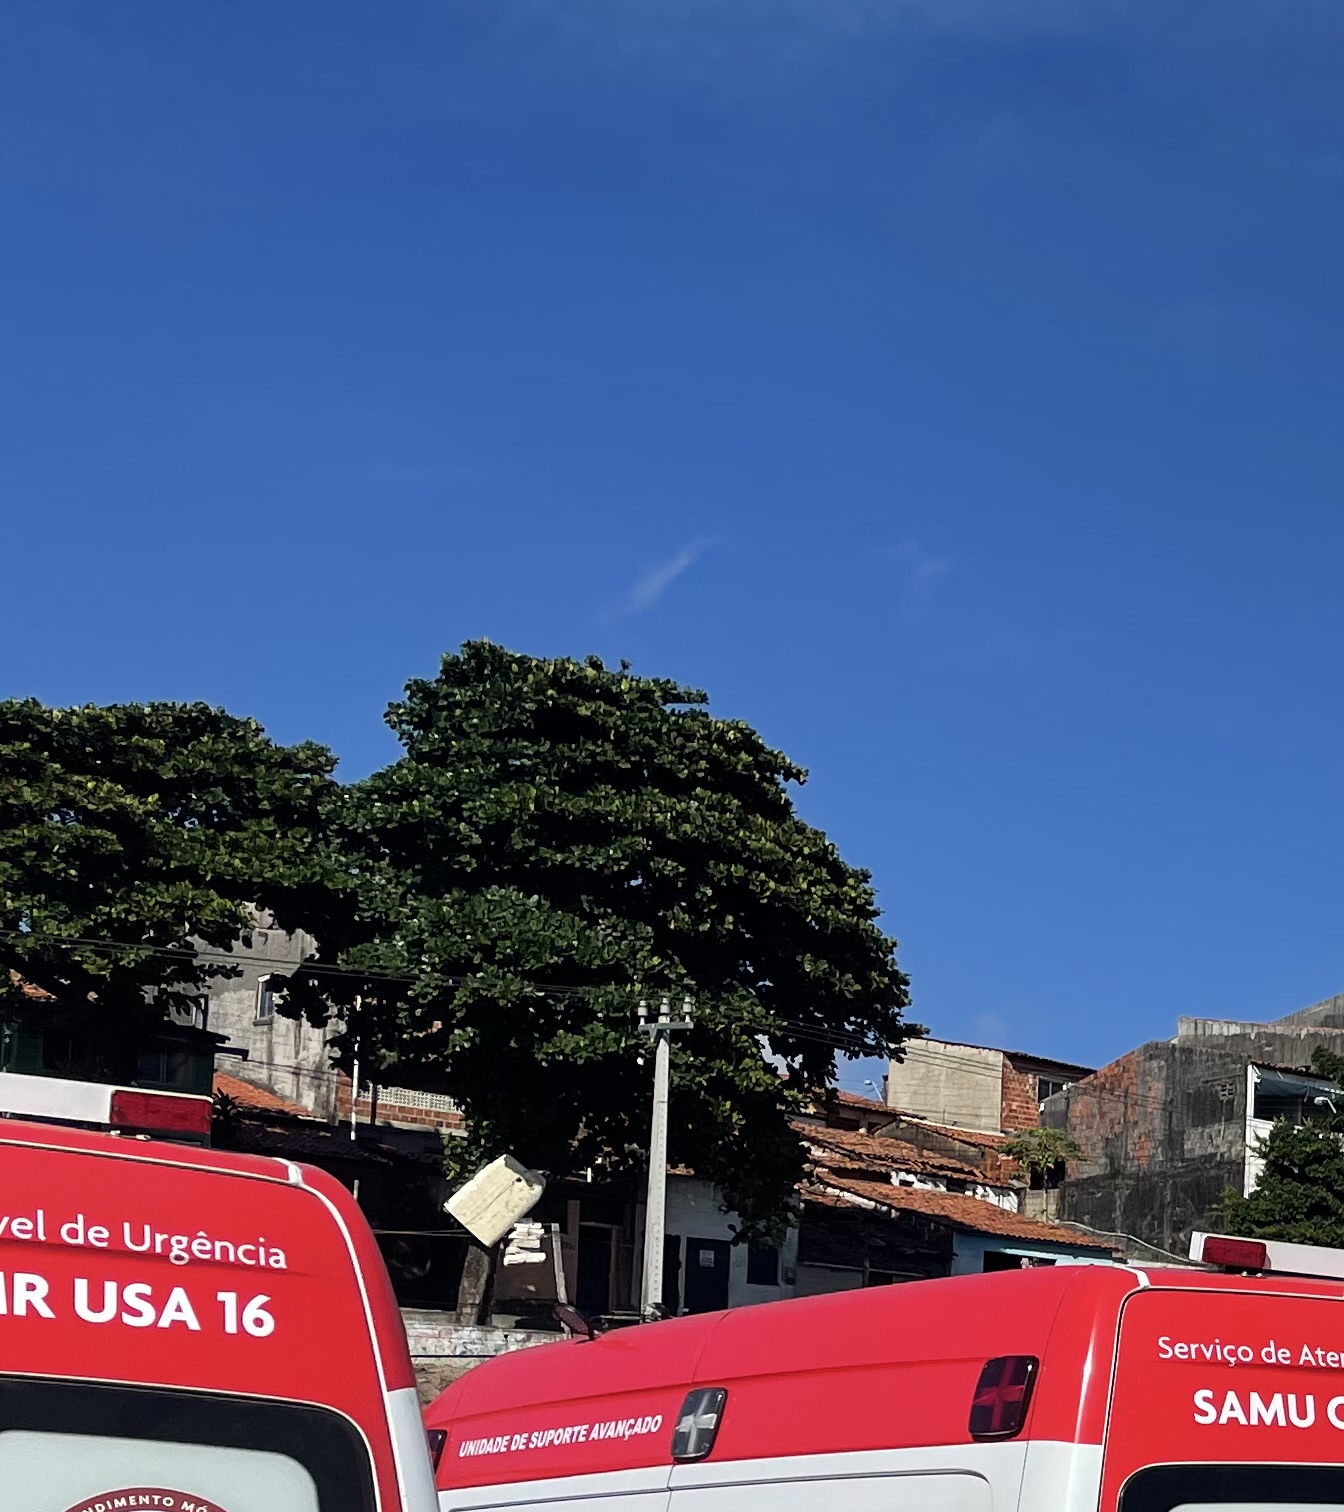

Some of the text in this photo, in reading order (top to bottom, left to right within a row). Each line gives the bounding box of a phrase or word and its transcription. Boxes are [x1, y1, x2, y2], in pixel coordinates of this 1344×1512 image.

[0, 1209, 287, 1269] vel de Urgência
[0, 1271, 275, 1338] R USA 16
[1157, 1336, 1254, 1368] Serviço
[1261, 1339, 1291, 1365] de
[1193, 1388, 1316, 1428] SAMU
[458, 1414, 663, 1458] UNIDADE DE SUPORTE AVANÇADO
